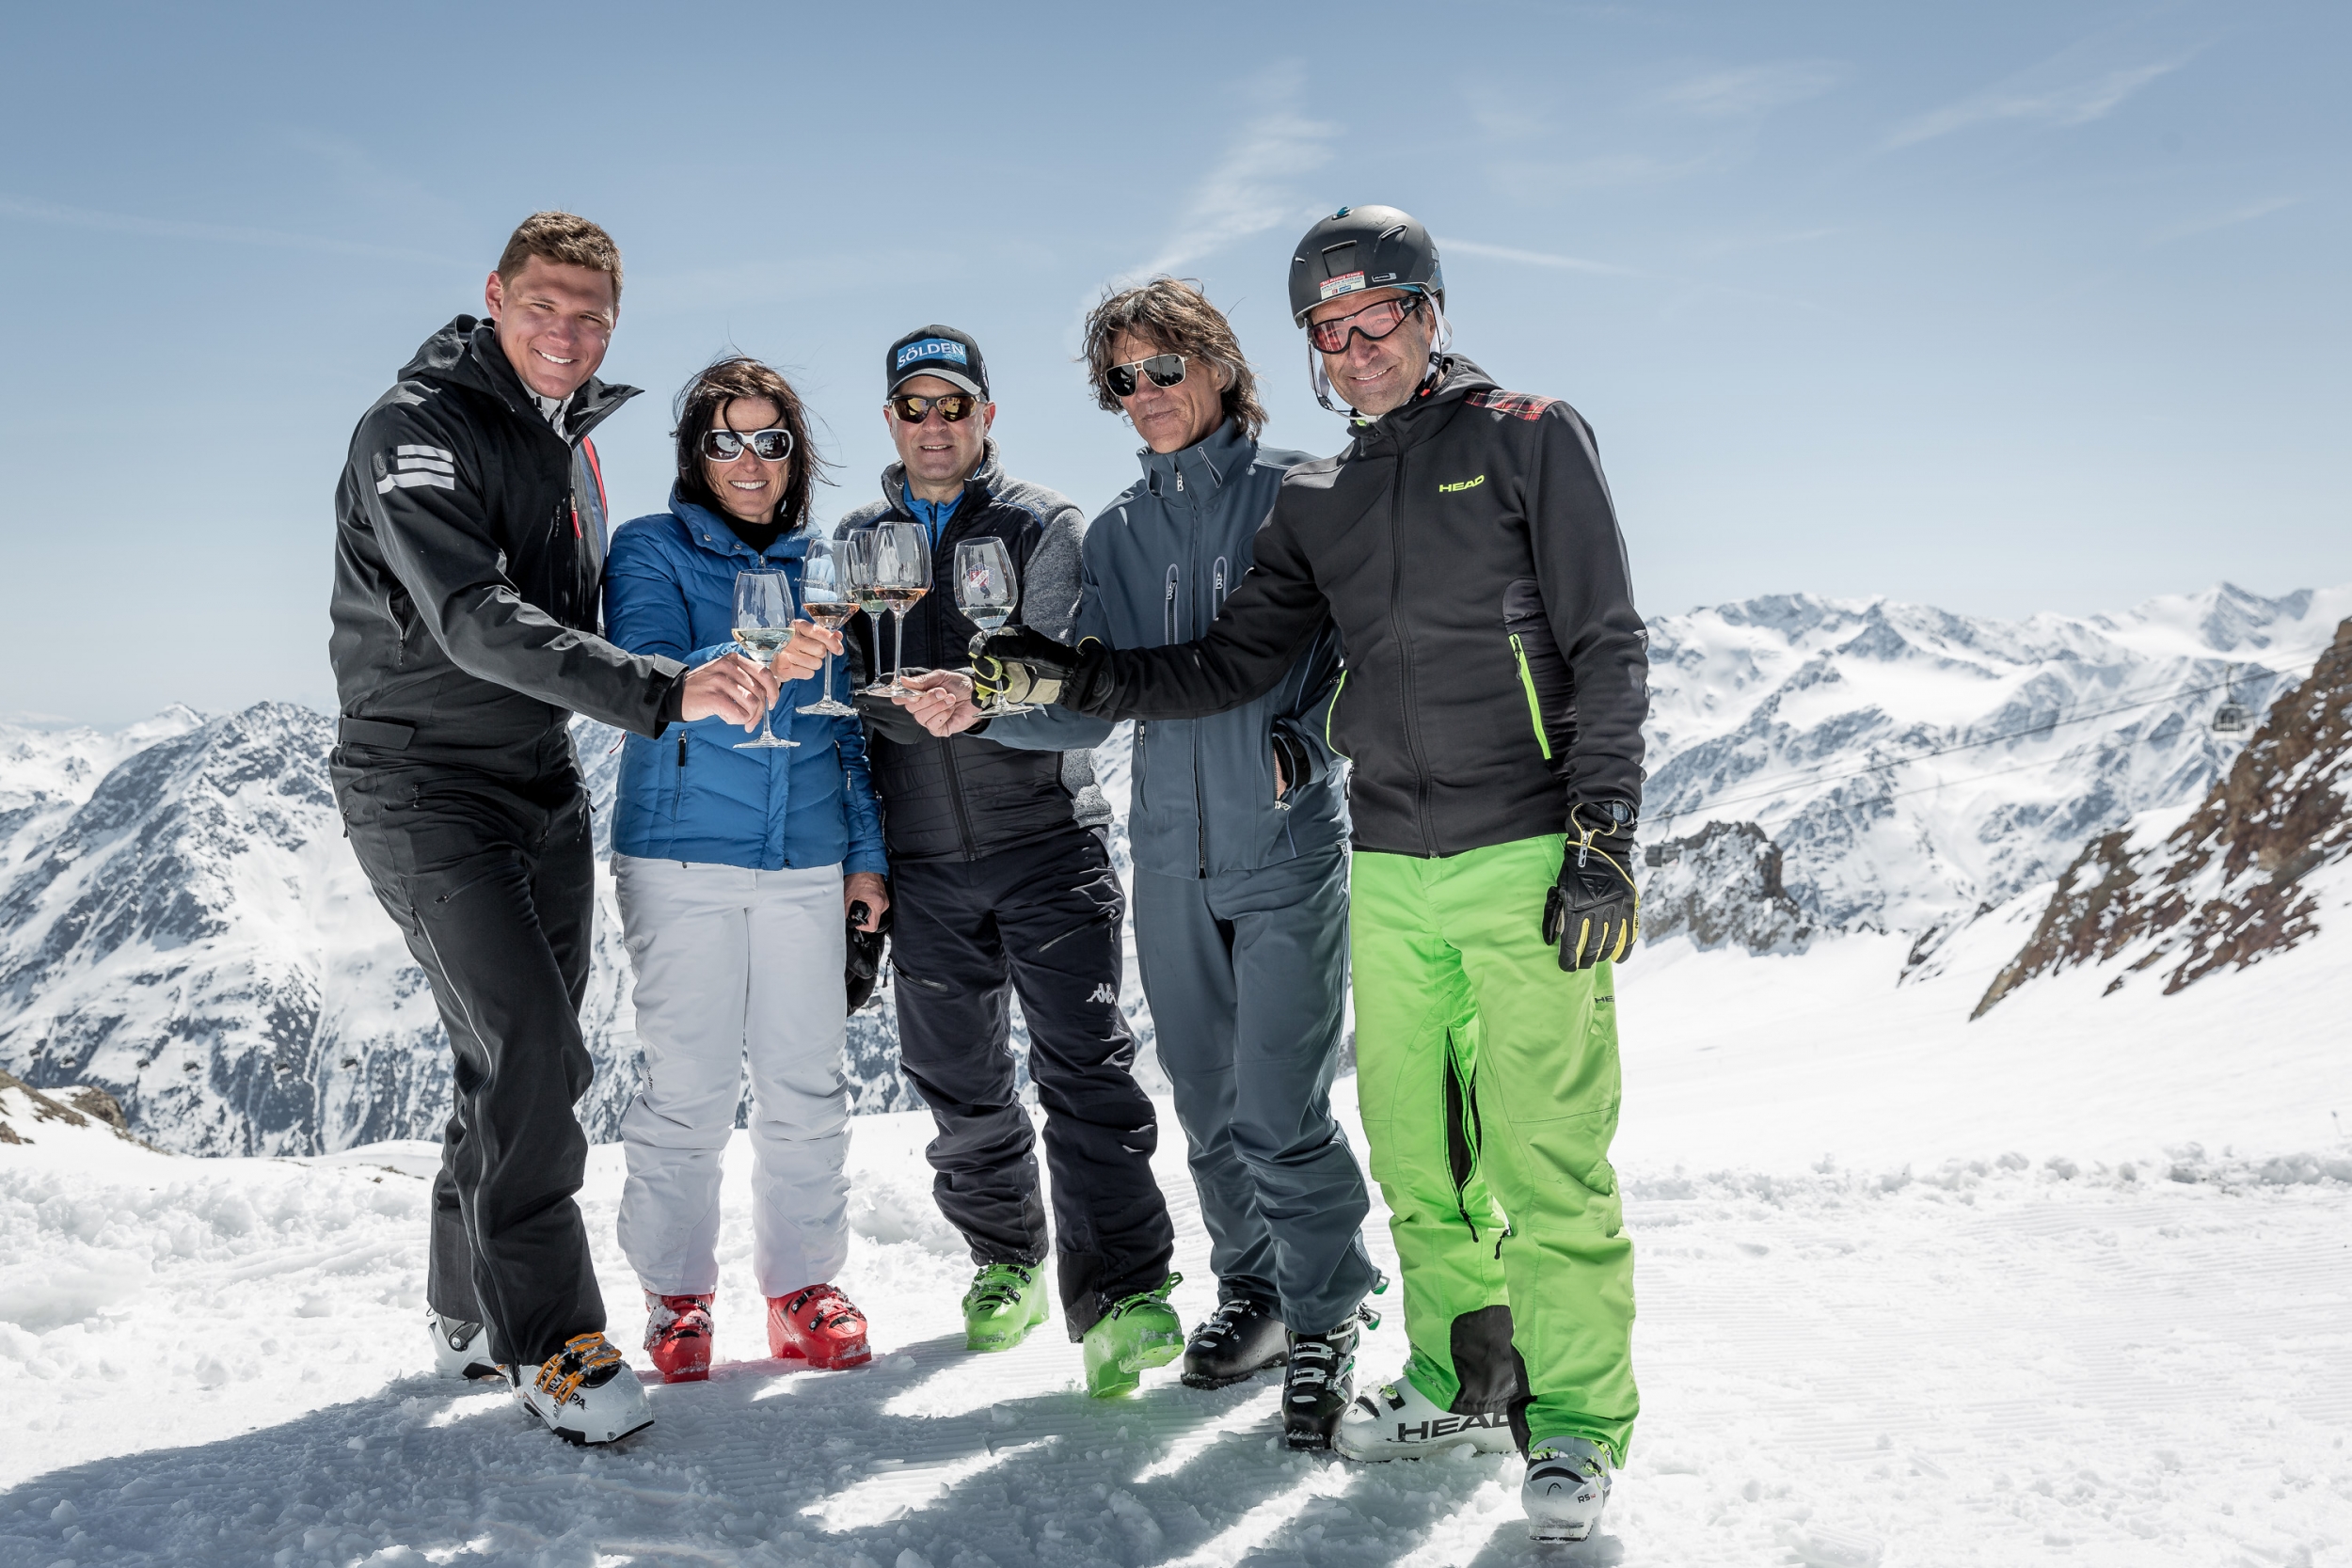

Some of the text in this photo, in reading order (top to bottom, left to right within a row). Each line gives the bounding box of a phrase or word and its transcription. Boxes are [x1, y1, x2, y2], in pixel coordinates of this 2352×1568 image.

[898, 342, 964, 367] SÖLDEN
[1438, 474, 1486, 492] HEAD
[1595, 995, 1614, 1004] HE
